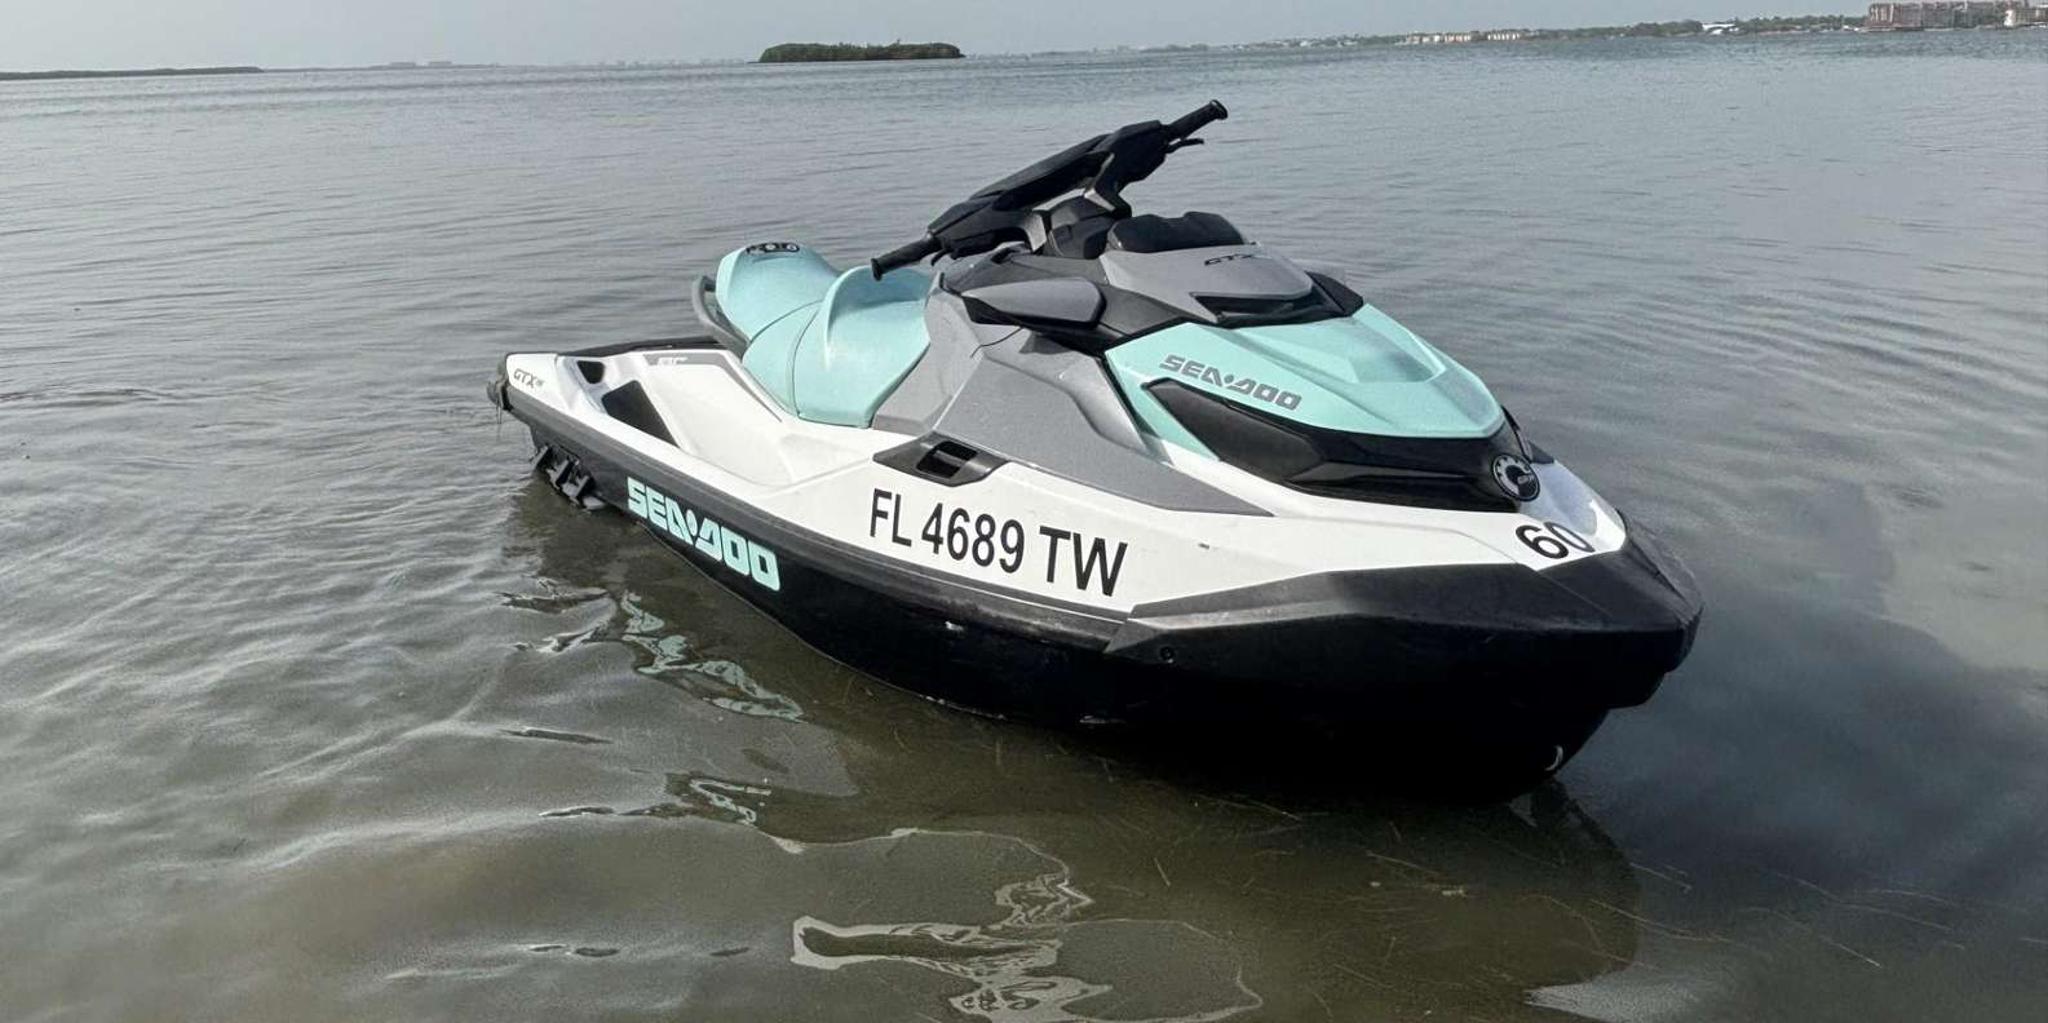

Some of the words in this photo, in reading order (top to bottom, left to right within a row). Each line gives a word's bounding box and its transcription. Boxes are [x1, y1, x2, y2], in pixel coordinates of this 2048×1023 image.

[870, 488, 912, 547] FL
[921, 502, 1025, 574] 4689
[1039, 525, 1128, 597] TW
[1515, 521, 1596, 559] 60
